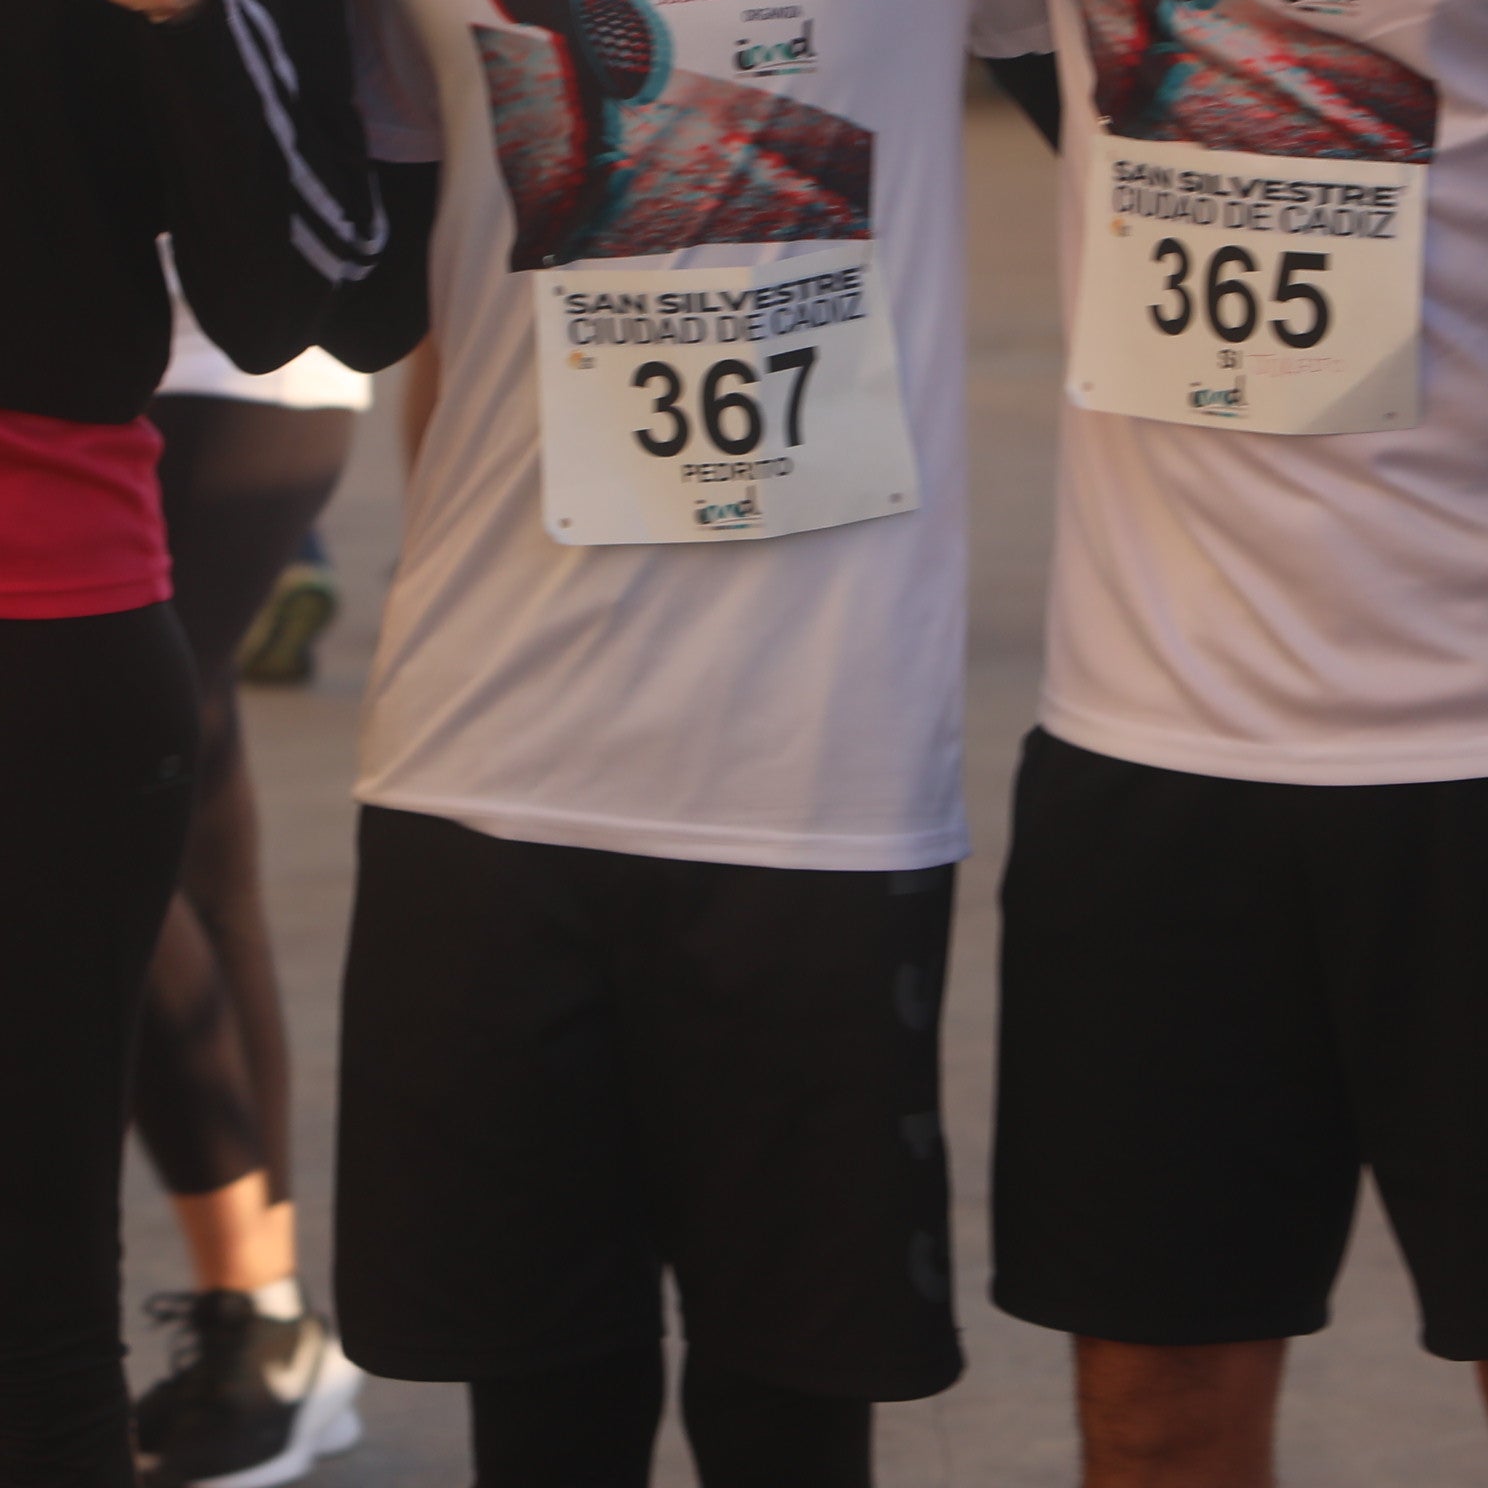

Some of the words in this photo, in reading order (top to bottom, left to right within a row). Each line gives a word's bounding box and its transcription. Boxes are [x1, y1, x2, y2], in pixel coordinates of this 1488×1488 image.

[1114, 160, 1175, 188] SAN
[1178, 170, 1400, 207] SILVESTRE
[1113, 184, 1216, 224] CIUDAD
[1223, 201, 1272, 231] DE
[565, 291, 643, 314] SAN
[657, 265, 864, 314] SILVESTRE
[1148, 237, 1331, 349] 365
[568, 315, 707, 345] CIUDAD
[718, 313, 766, 342] DE
[631, 345, 818, 458] 367
[681, 457, 794, 483] PEDRITO
